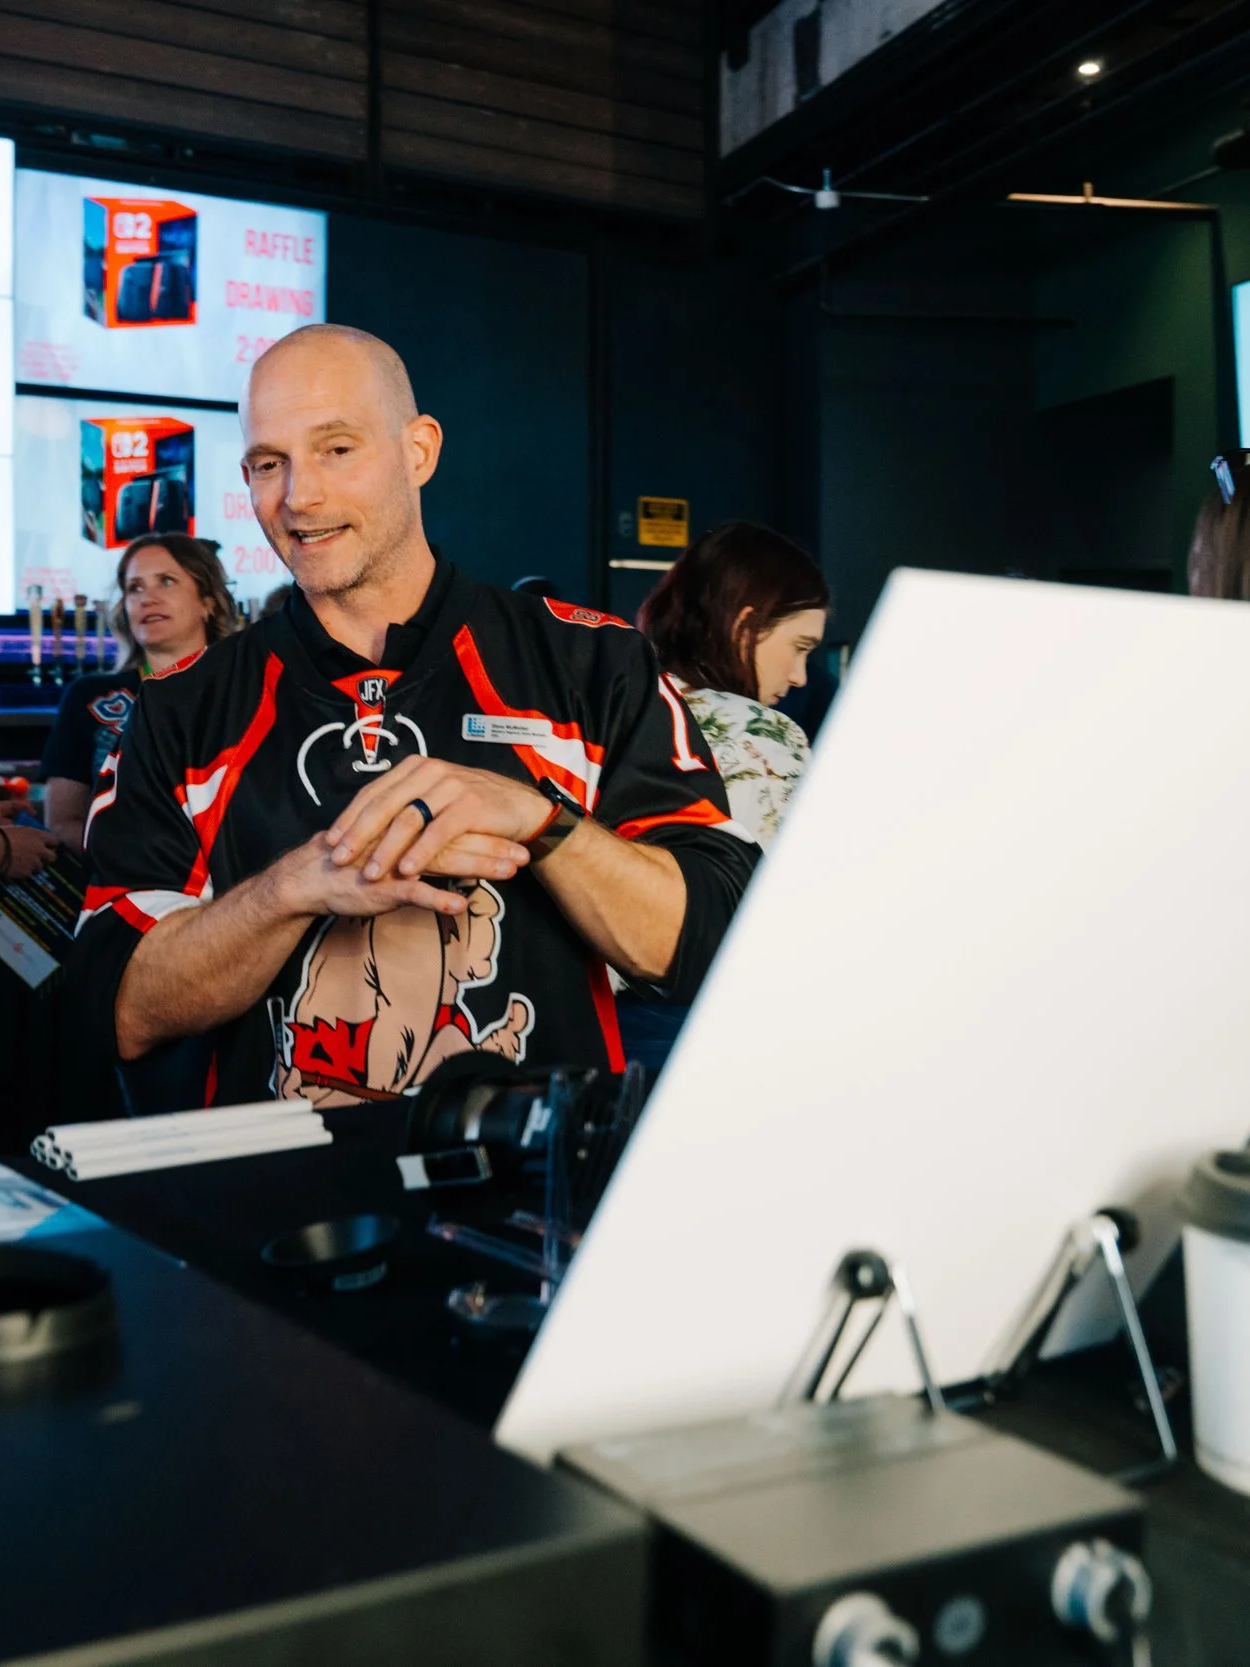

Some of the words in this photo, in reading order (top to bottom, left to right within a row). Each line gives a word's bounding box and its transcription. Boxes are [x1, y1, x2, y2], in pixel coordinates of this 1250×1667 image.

[244, 228, 315, 265] RAFFLE
[225, 280, 314, 317] DRAWING
[360, 679, 387, 701] JFX
